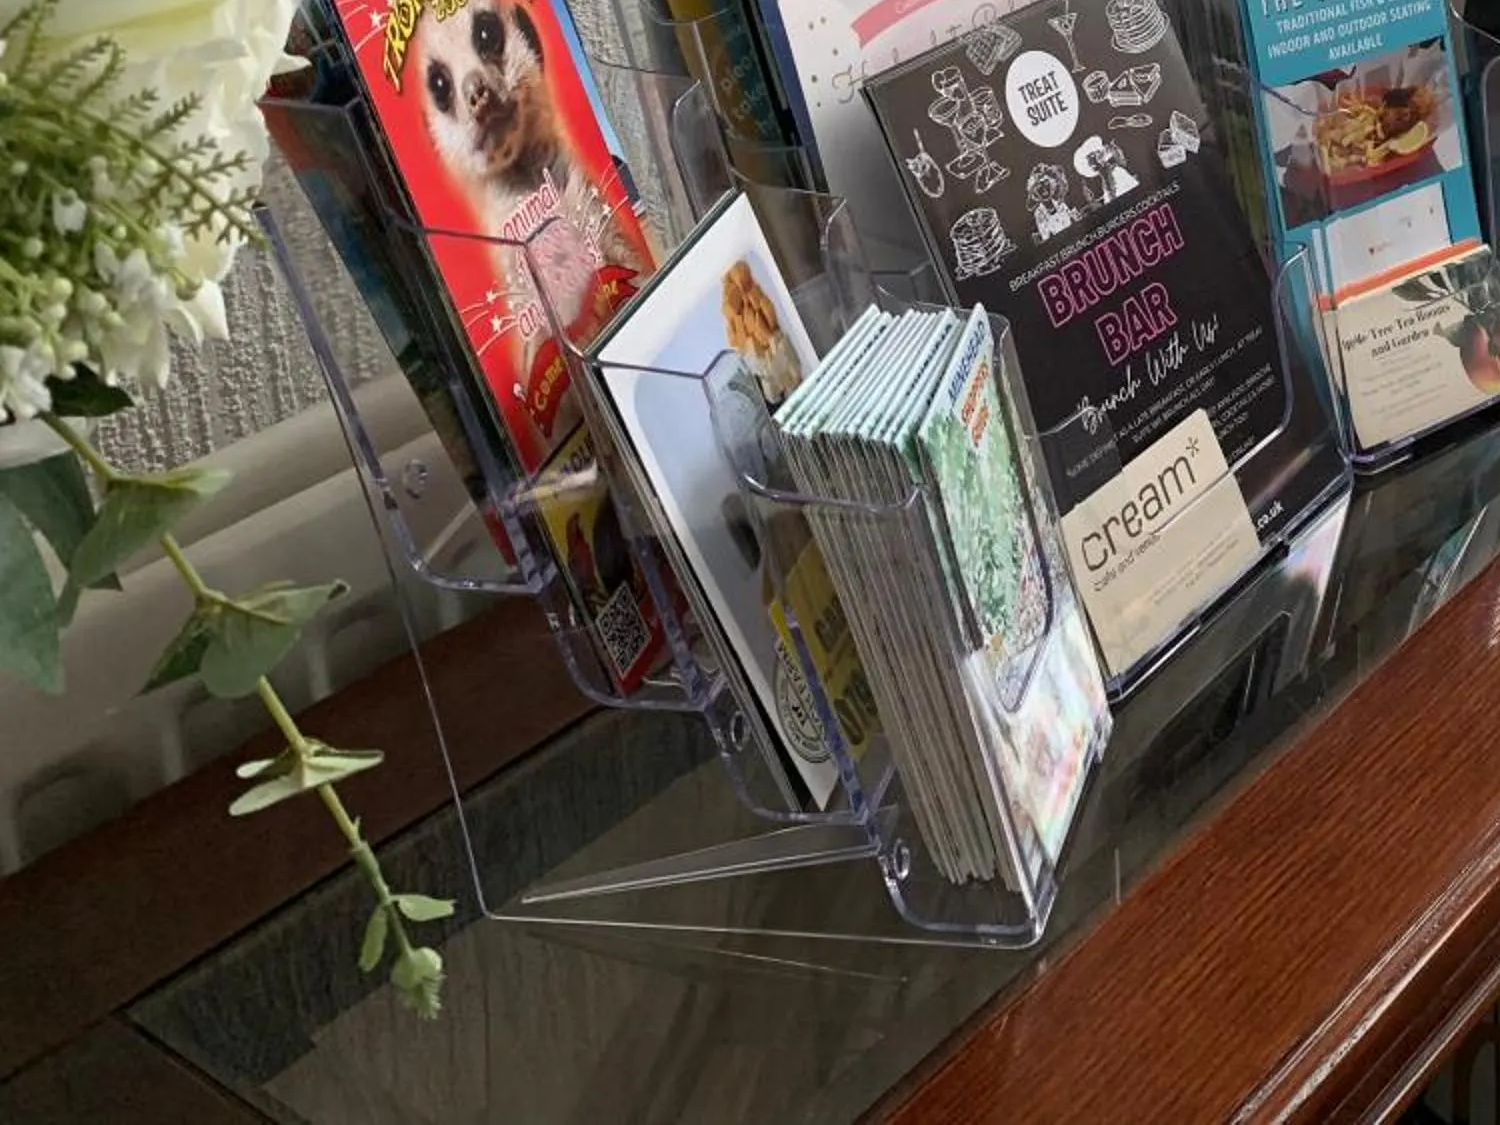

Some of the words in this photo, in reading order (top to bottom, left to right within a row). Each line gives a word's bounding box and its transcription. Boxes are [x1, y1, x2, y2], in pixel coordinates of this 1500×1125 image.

[1267, 35, 1311, 59] INDOOR
[1313, 29, 1336, 46] AND
[1338, 12, 1388, 41] OUTDOOR
[1390, 0, 1432, 23] SEATING
[1277, 4, 1348, 35] TRADITIONAL
[1329, 33, 1384, 61] AVAILABLE
[1017, 70, 1060, 106] TREAT
[1025, 90, 1068, 126] SUITE
[1036, 202, 1186, 328] BRUNCH
[1095, 282, 1178, 367] BAR
[1145, 330, 1190, 386] With
